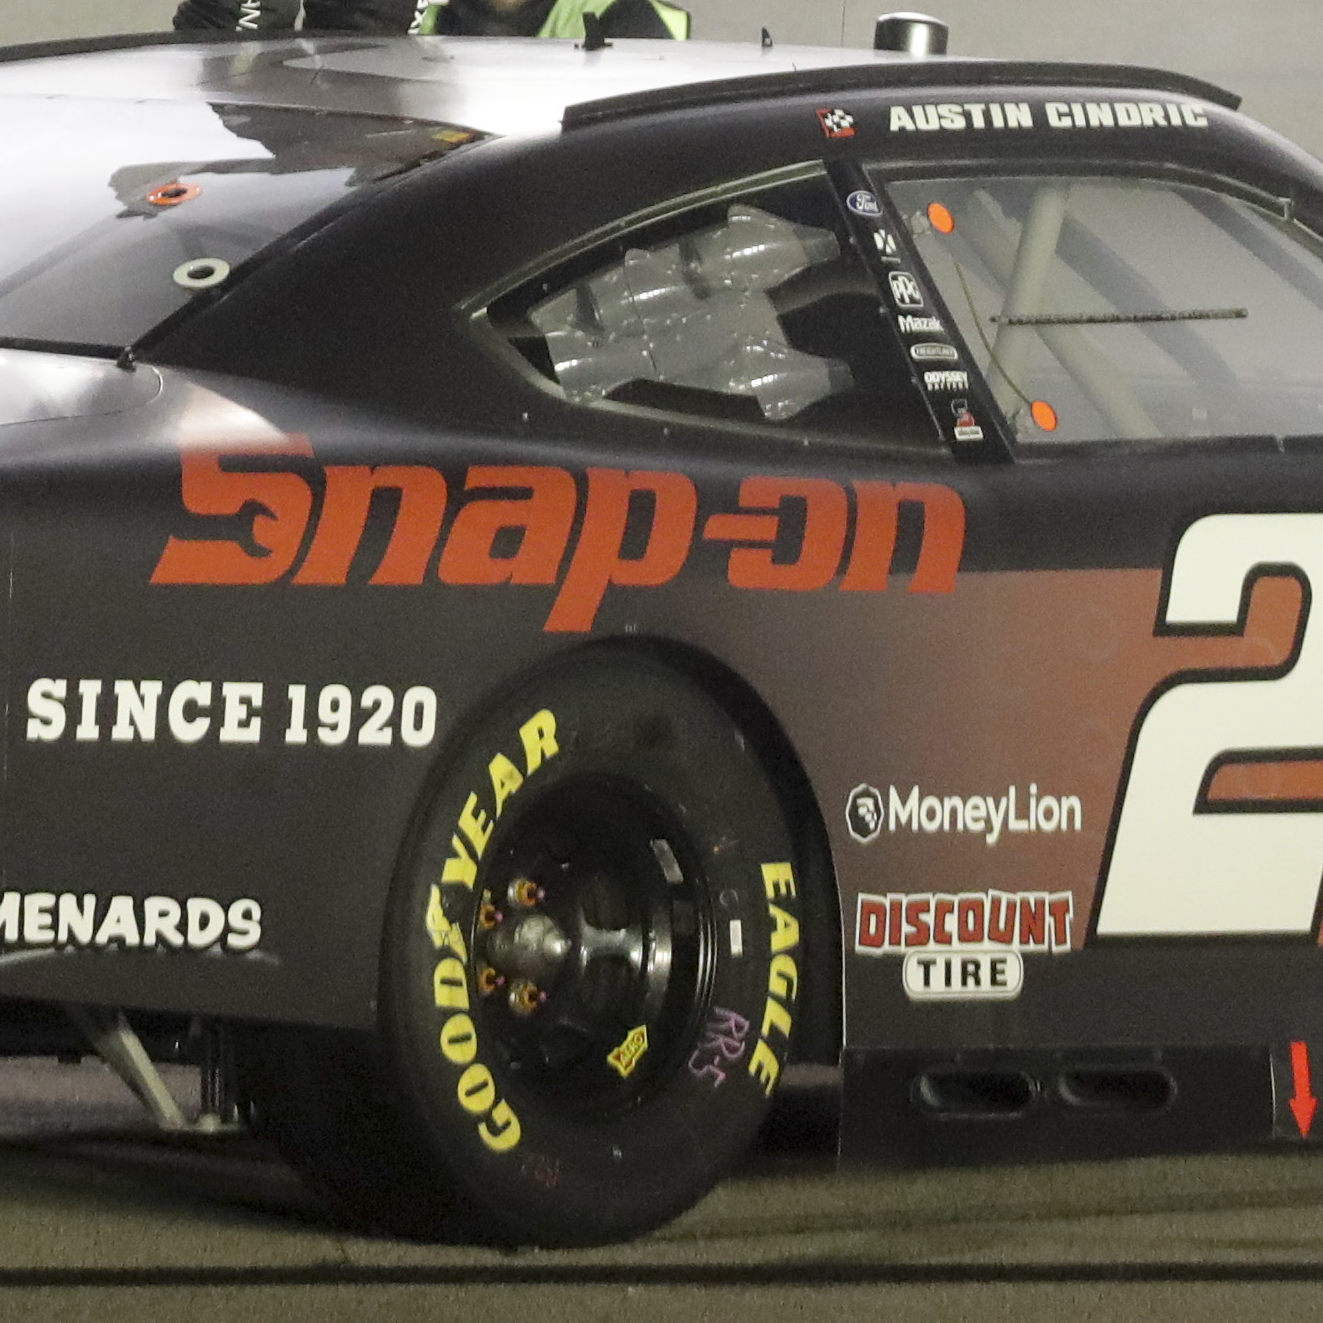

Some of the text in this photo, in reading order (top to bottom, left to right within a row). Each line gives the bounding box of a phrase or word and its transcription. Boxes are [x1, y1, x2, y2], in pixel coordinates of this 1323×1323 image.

[889, 102, 1209, 132] AUSTIN CINDRIC
[855, 192, 881, 213] Ford
[891, 275, 922, 305] PPG
[897, 314, 945, 334] Mazak
[149, 430, 968, 633] Snap-on
[25, 676, 439, 748] SINCE 1920
[887, 781, 1083, 845] MoneyLion
[856, 890, 1073, 952] DISCOUNT
[747, 861, 800, 1098] EAGLE
[915, 956, 1009, 989] TIRE
